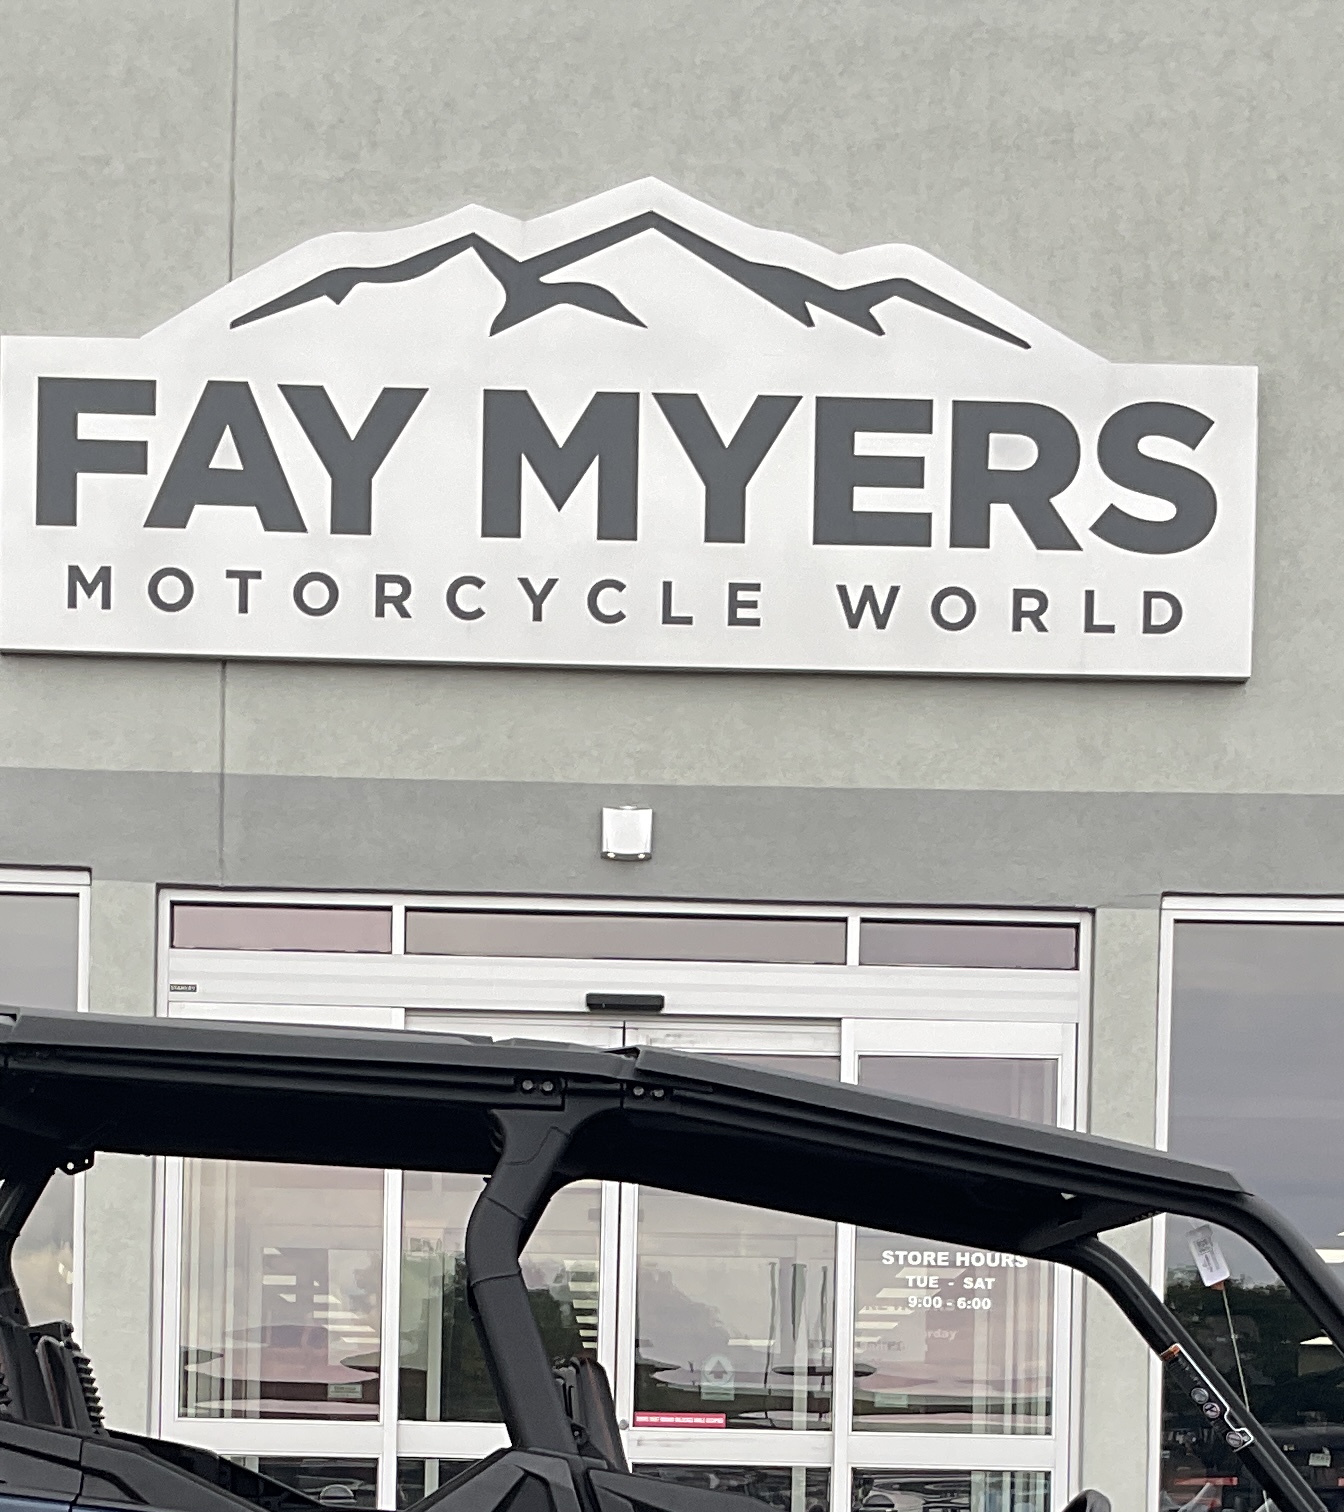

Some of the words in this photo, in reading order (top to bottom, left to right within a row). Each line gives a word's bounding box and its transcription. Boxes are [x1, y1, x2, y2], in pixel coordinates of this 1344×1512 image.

[35, 376, 430, 536] FAY
[480, 388, 1218, 555] MYERS
[67, 564, 762, 627] MOTORCYCLE
[835, 584, 1183, 635] WORLD
[881, 1250, 950, 1266] STORE
[956, 1252, 1028, 1268] HOURS
[906, 1276, 940, 1288] TUE
[963, 1277, 995, 1290] SAT
[908, 1296, 943, 1308] 9:00
[957, 1297, 992, 1310] 6:00
